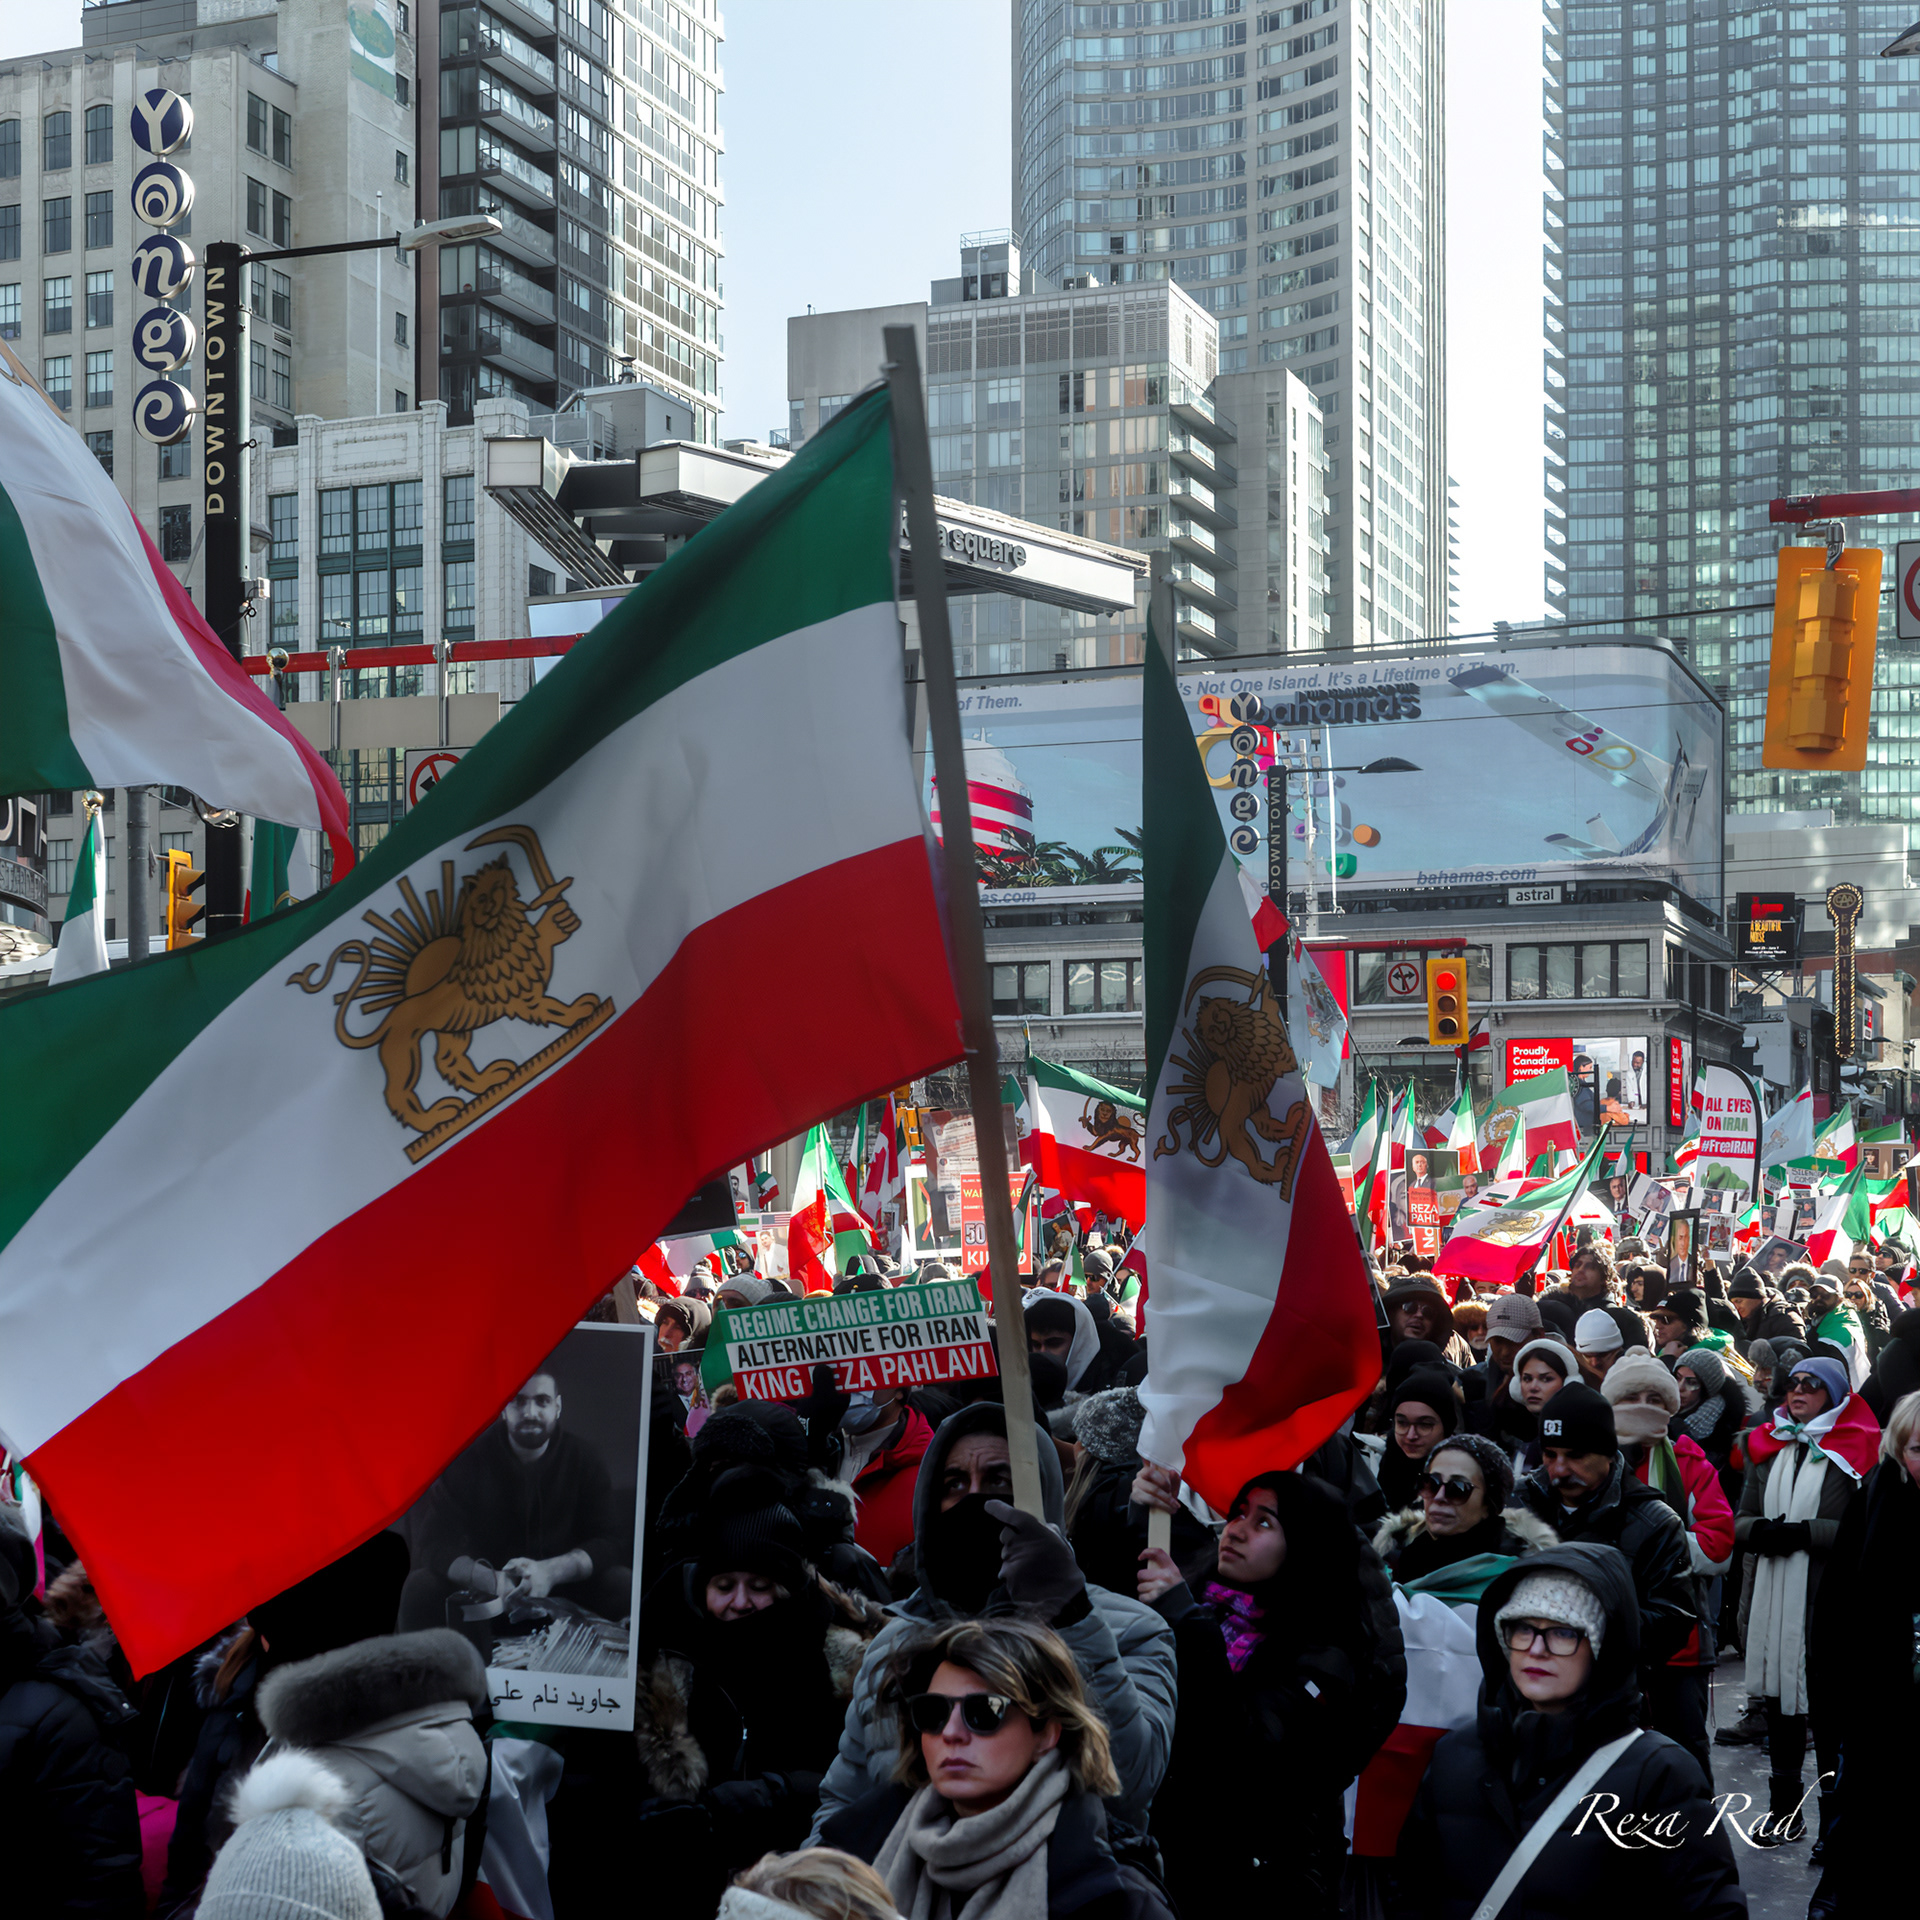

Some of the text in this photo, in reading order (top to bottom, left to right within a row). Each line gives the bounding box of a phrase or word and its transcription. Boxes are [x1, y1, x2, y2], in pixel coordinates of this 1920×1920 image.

[133, 91, 178, 440] Yonge
[206, 266, 225, 515] DOWNTOWN
[952, 528, 1027, 568] square
[1197, 680, 1225, 695] Not
[1230, 678, 1263, 693] One
[1268, 674, 1321, 691] Island.
[1328, 671, 1353, 686] It's
[1358, 672, 1367, 685] a
[1372, 667, 1440, 684] Lifetime
[1446, 663, 1465, 678] of
[1469, 661, 1519, 675] Tm.
[959, 695, 1022, 710] of Them.
[1231, 693, 1255, 853] Yonge
[1271, 776, 1281, 890] DOWNTOWN
[1417, 868, 1537, 885] bahamas.com
[1516, 888, 1554, 901] astral
[1835, 893, 1855, 904] CAA
[1841, 914, 1849, 936] ED
[1840, 945, 1850, 1037] MIRVISH
[1513, 1046, 1549, 1057] Proudly
[1513, 1057, 1559, 1066] Canadian
[1513, 1067, 1545, 1076] owned
[1705, 1097, 1752, 1113] ALL EYES
[1707, 1116, 1748, 1132] ON IRAN
[1701, 1138, 1754, 1154] #FreeIRAN
[1411, 1203, 1438, 1214] REZA
[728, 1283, 976, 1340] REGIME CHANGE FOR IRAN
[738, 1315, 981, 1369] ALTERNATIVE FOR IRAN
[742, 1345, 990, 1400] KING ZA PAHLAVI
[1544, 1420, 1562, 1436] DC
[532, 1684, 559, 1712] نام
[567, 1688, 621, 1713] جاوید
